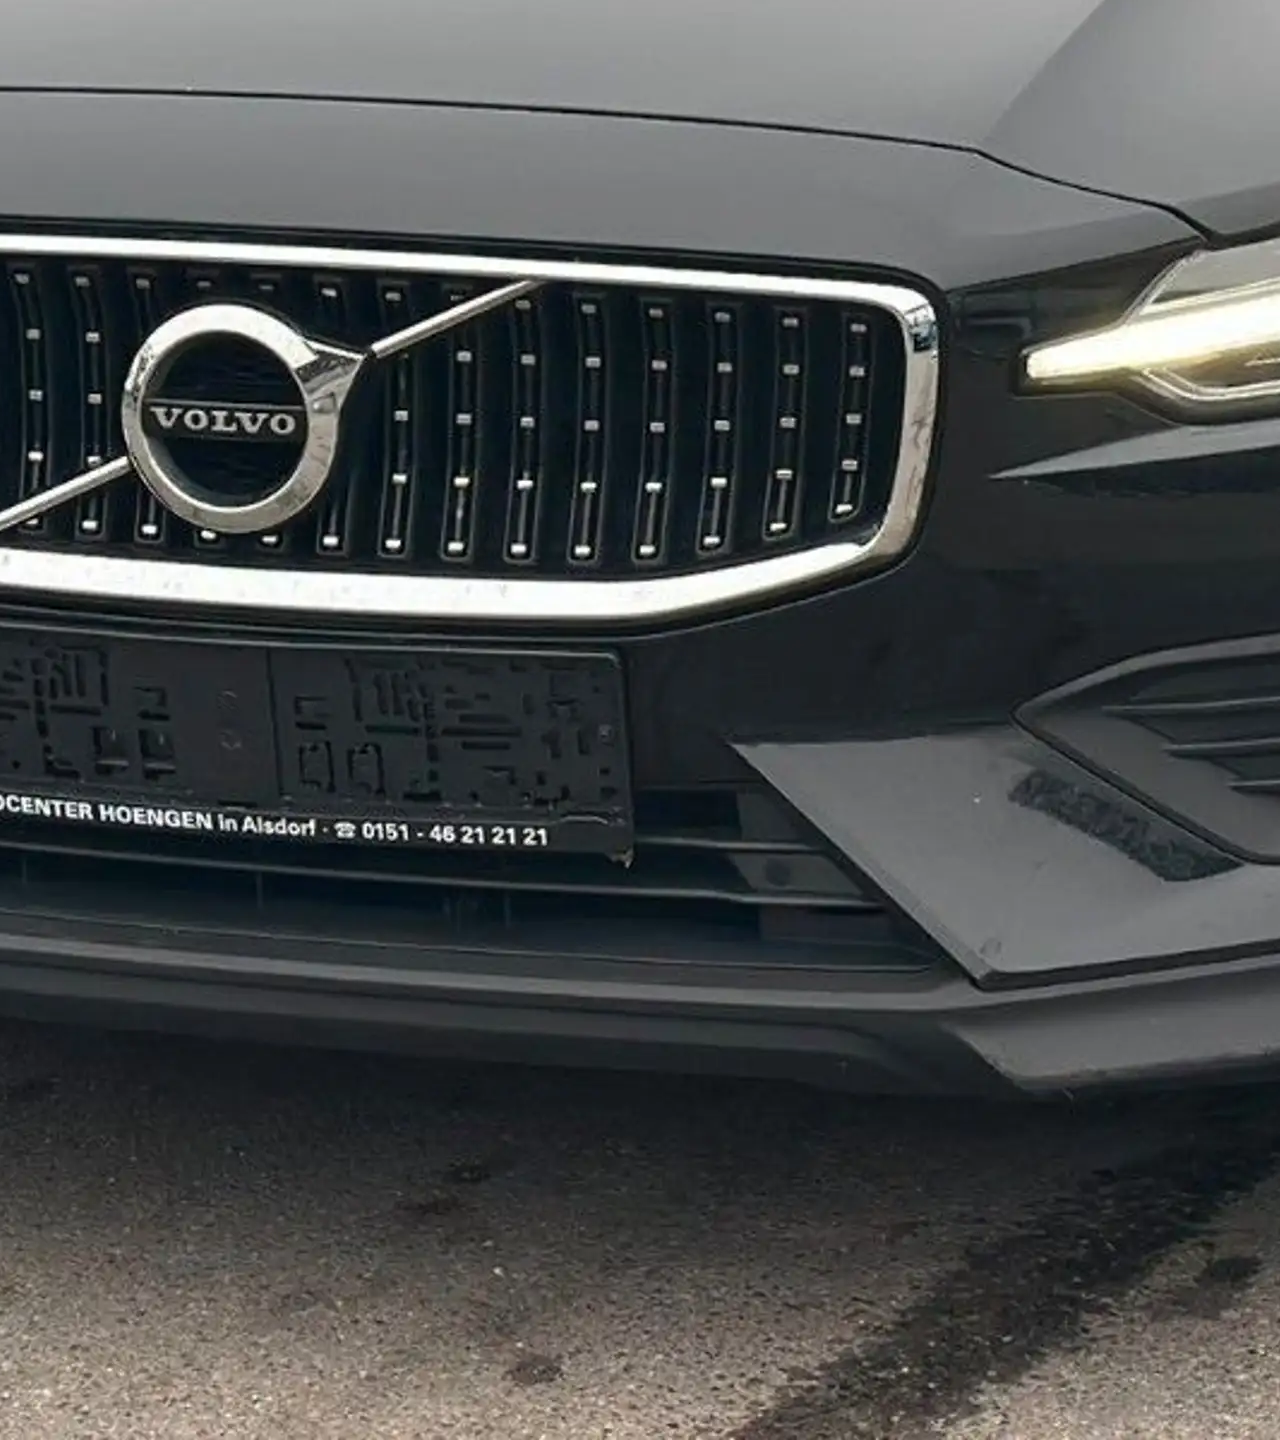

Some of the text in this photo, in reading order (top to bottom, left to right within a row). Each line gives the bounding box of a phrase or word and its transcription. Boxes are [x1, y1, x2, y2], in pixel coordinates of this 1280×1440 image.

[150, 407, 296, 435] VOLVO
[99, 804, 214, 831] HOENGEN
[218, 813, 238, 832] in
[242, 815, 316, 837] Alsdorf
[362, 822, 410, 842] 0151
[429, 825, 456, 844] 46
[461, 826, 485, 845] 21
[491, 827, 517, 846] 21
[523, 828, 548, 847] 21
